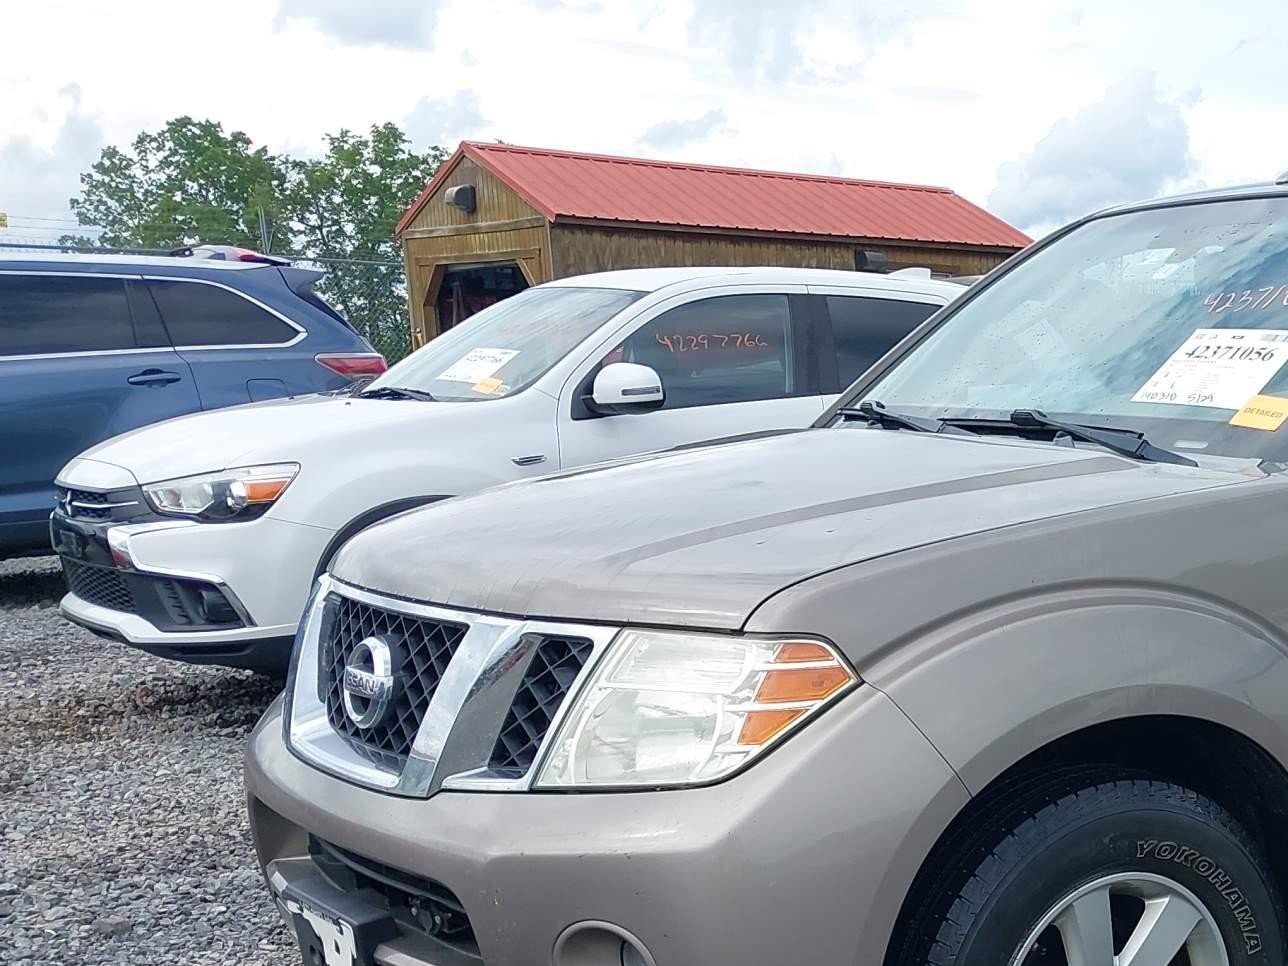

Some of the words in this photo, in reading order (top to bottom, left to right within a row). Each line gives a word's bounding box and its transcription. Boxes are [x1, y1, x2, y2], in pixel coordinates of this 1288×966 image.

[1184, 345, 1279, 362] 42371056
[1243, 407, 1284, 418] DETAILED
[1135, 840, 1262, 955] YOKOHAMA
